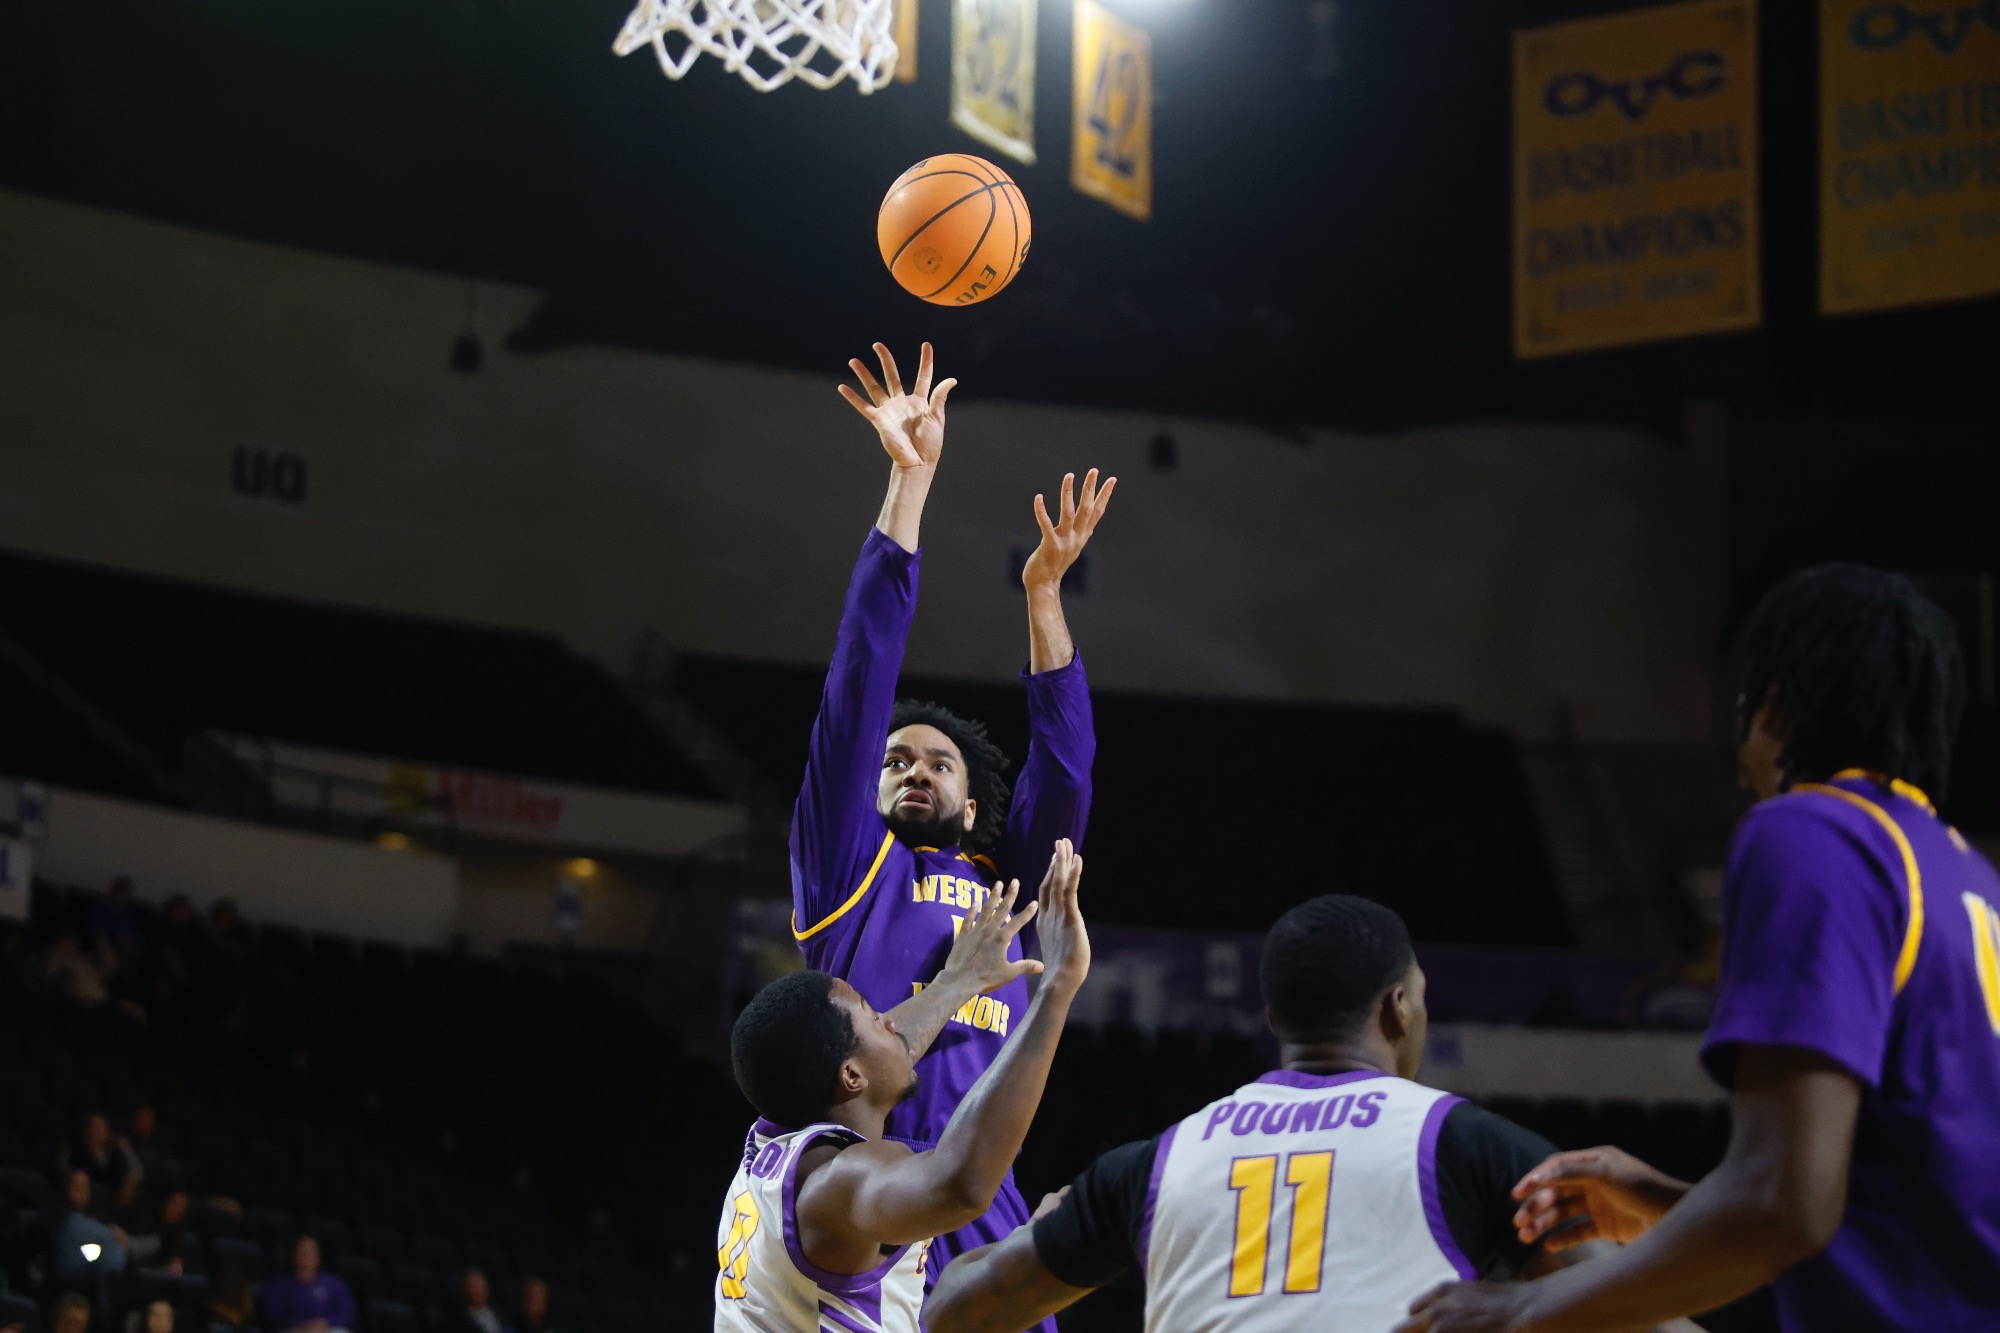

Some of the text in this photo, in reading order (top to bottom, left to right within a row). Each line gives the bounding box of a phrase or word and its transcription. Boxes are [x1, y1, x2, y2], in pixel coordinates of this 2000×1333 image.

[1544, 50, 1730, 120] OVC
[1202, 1091, 1387, 1140] POUNDS
[1227, 1148, 1336, 1298] 11
